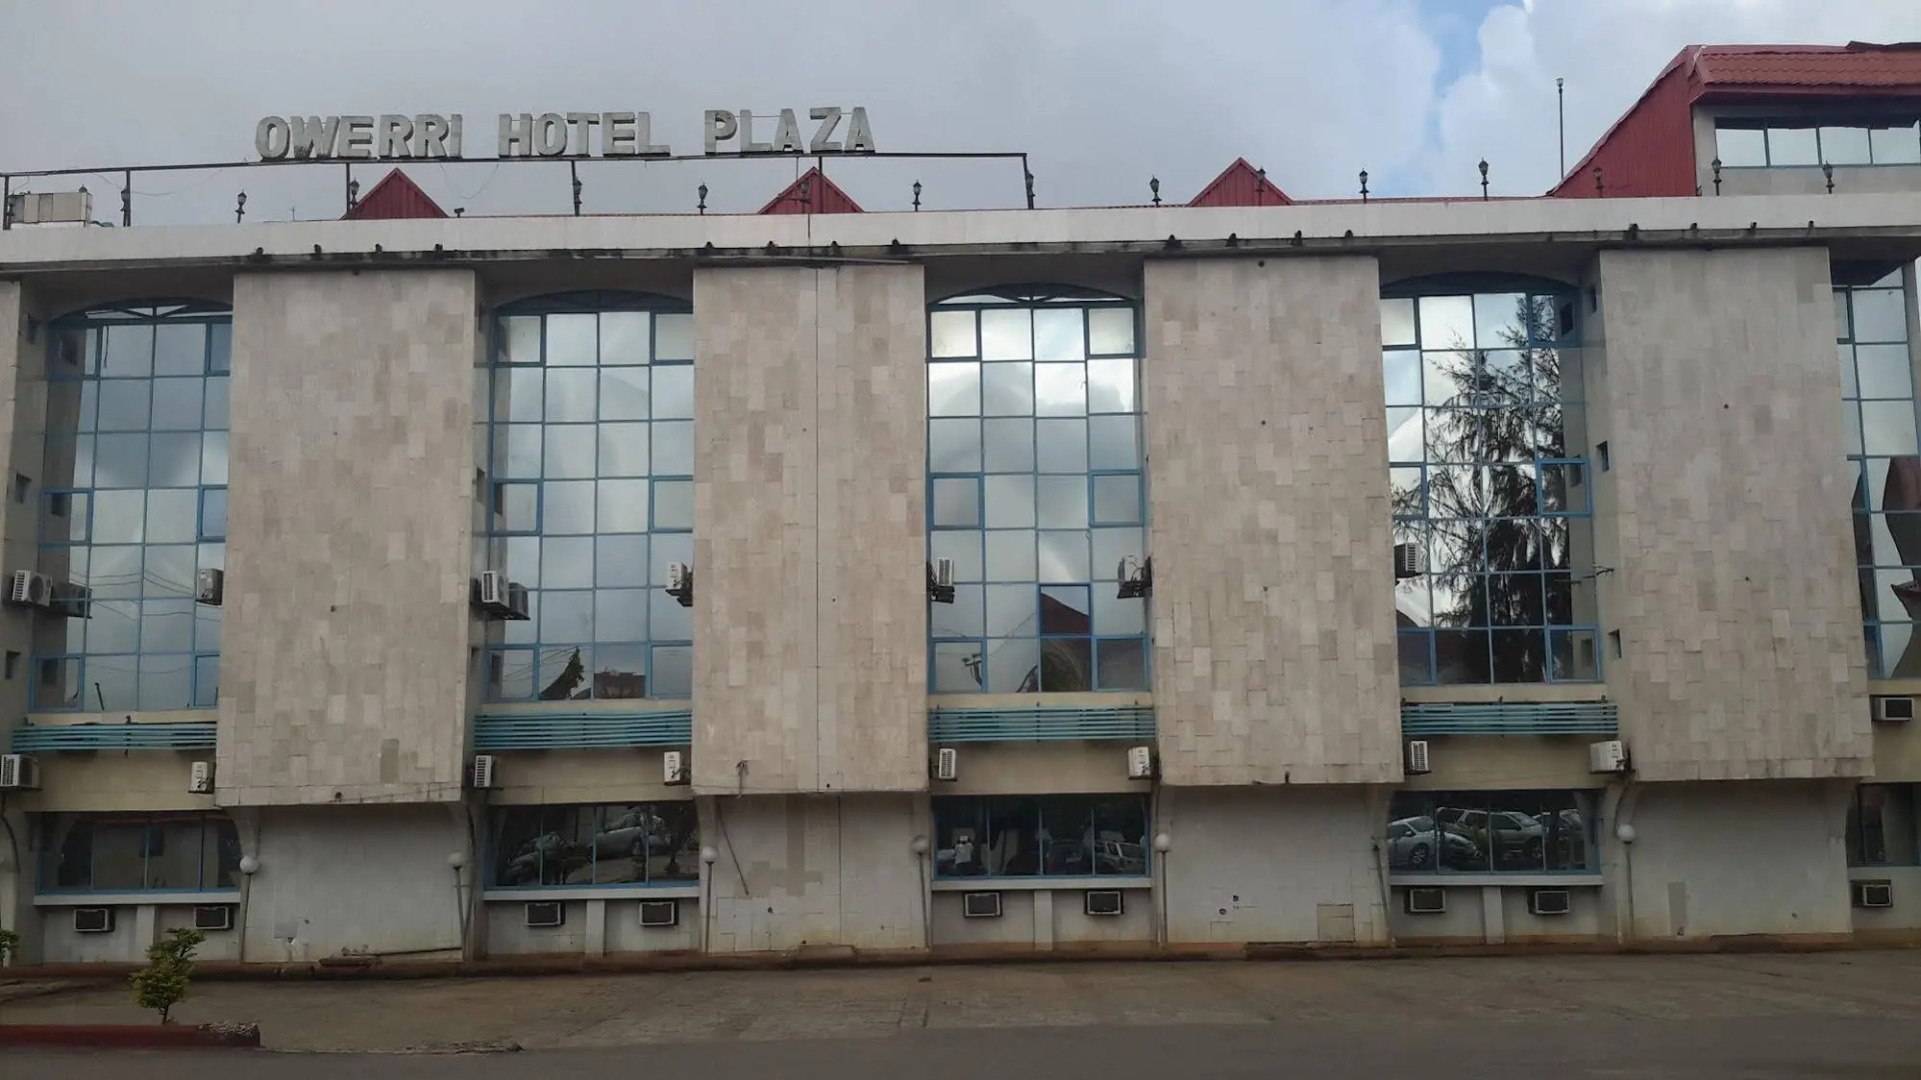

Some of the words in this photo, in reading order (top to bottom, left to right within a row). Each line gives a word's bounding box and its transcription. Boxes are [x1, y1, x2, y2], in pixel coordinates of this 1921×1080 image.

[255, 114, 462, 160] OWERRI
[499, 111, 670, 157] HOTEL
[704, 106, 876, 154] PLAZA
